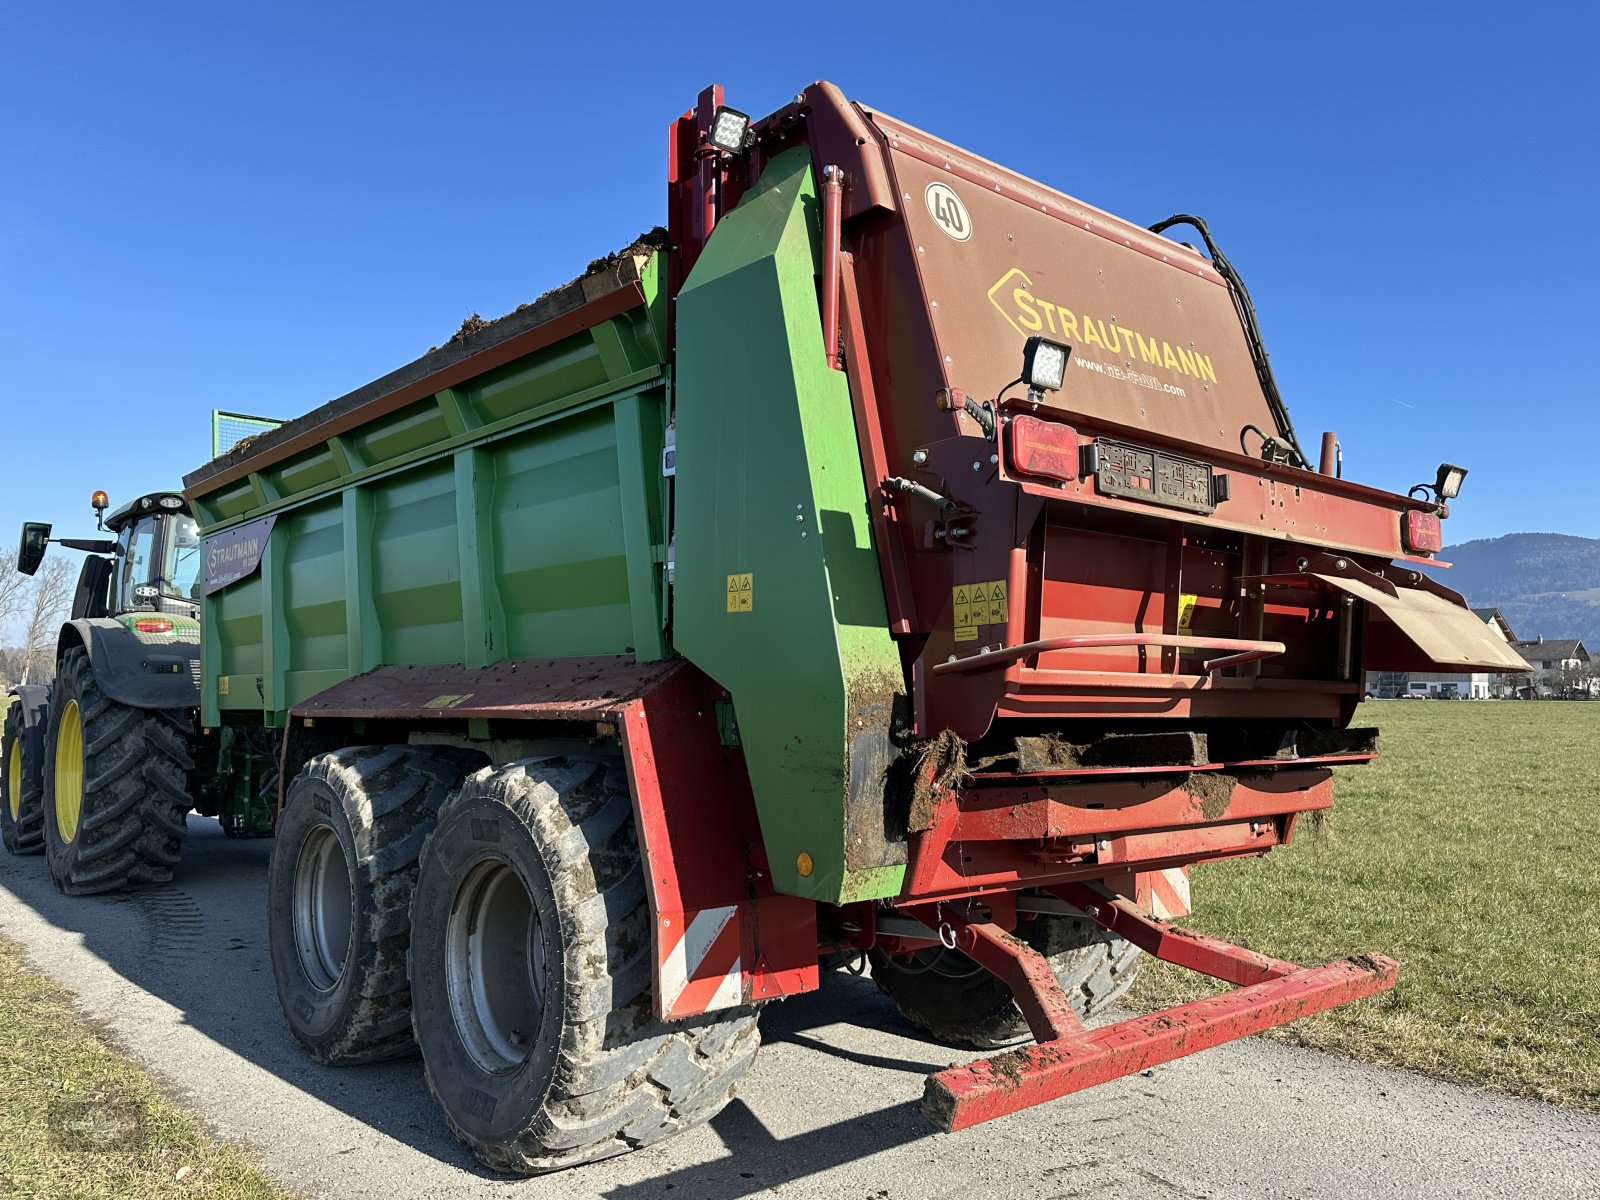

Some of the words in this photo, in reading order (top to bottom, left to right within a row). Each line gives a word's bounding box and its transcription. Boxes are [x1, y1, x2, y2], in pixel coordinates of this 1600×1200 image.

[934, 192, 964, 233] 40
[1013, 287, 1218, 385] STRAUTMANN
[210, 538, 259, 568] STRAUTMANN
